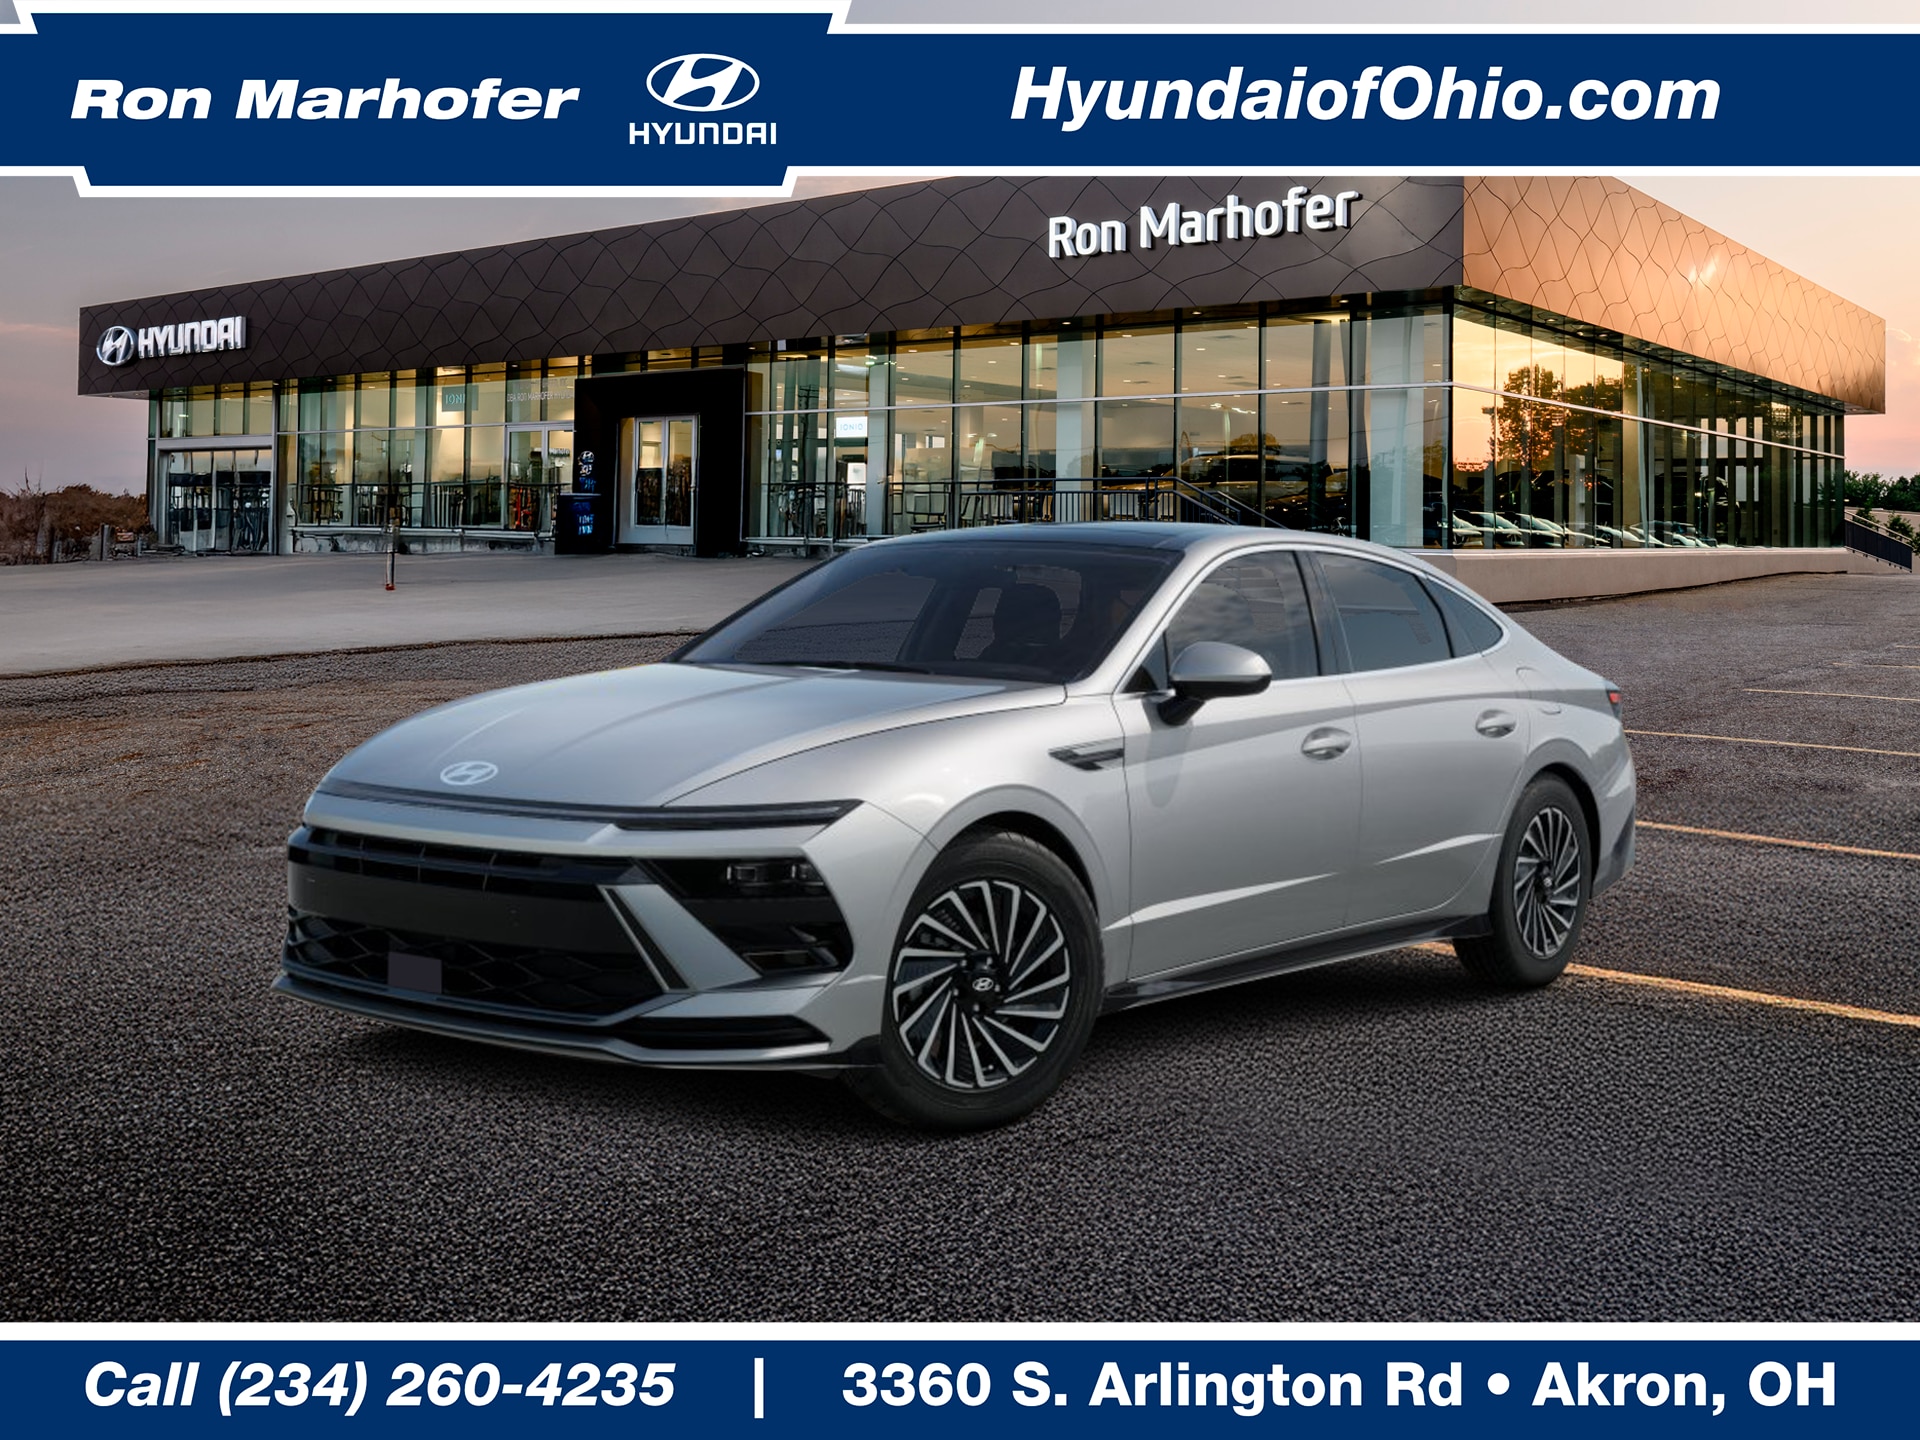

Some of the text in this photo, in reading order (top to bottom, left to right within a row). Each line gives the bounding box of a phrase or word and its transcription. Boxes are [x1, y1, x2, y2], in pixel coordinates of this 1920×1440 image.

[1048, 187, 1361, 258] Ron Marhofer
[138, 316, 247, 359] HYUNDAI
